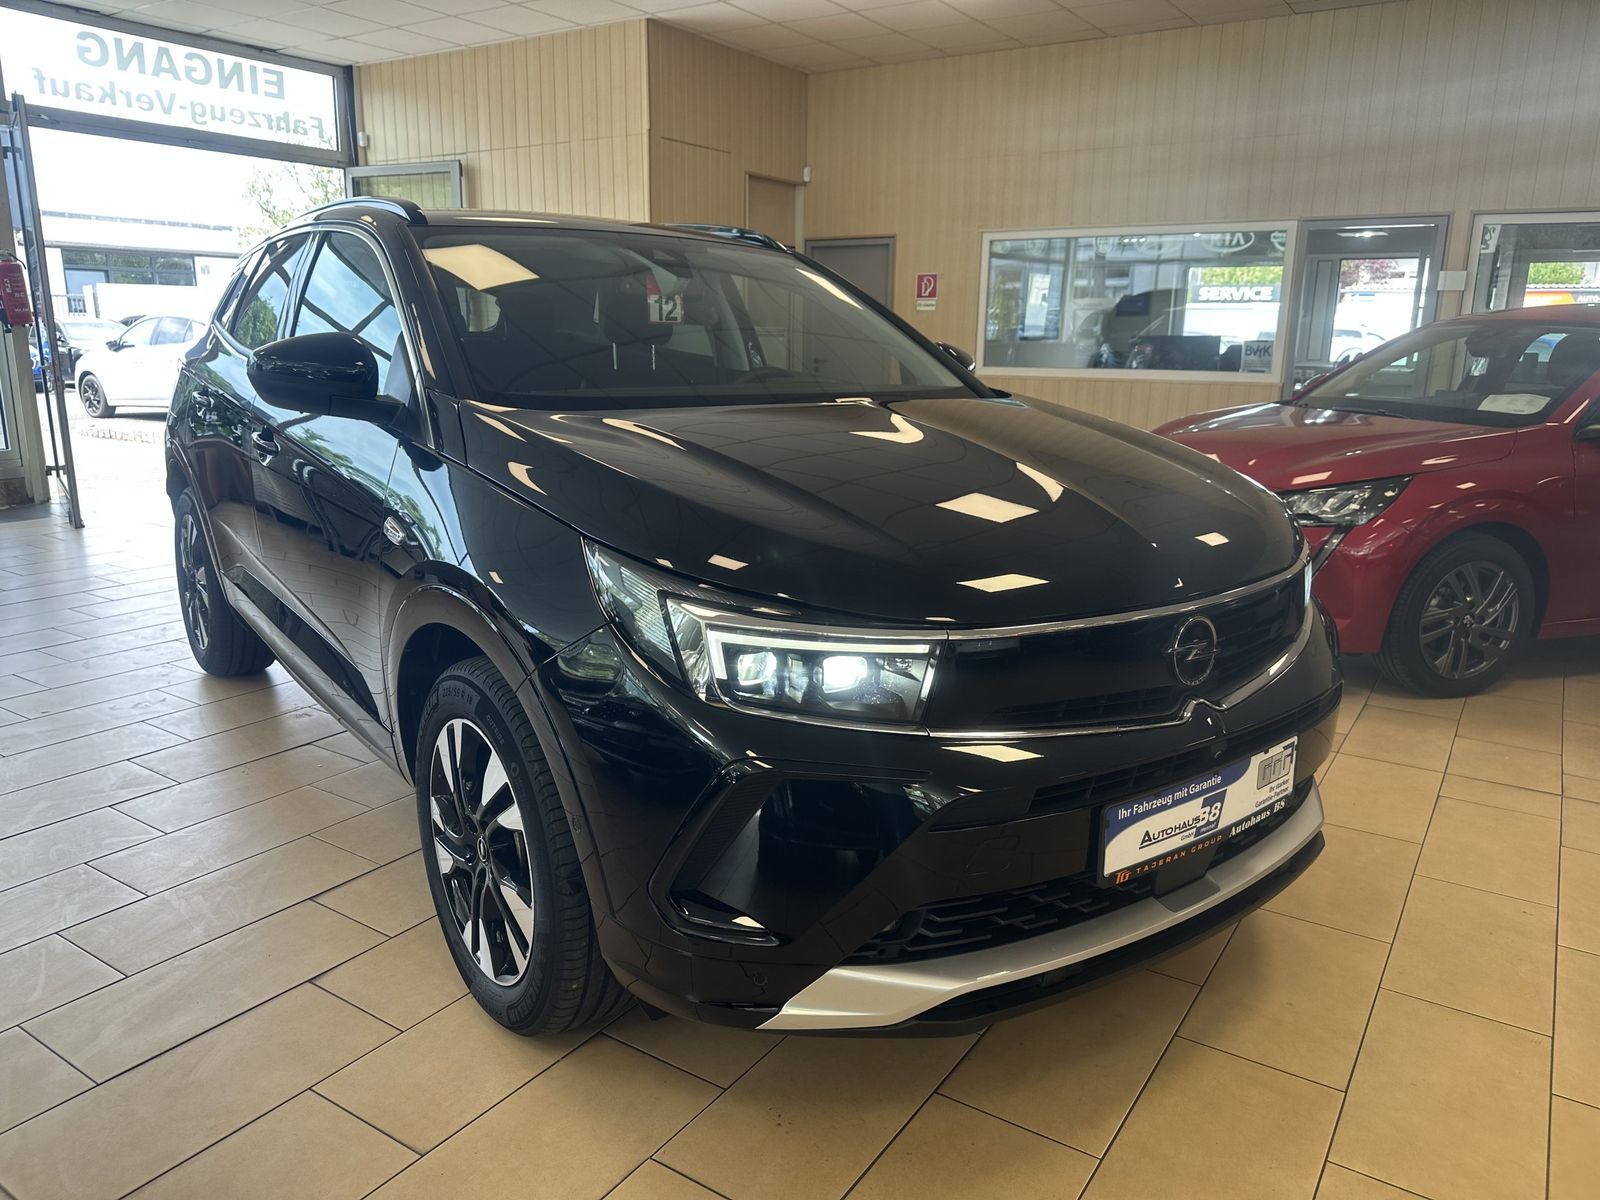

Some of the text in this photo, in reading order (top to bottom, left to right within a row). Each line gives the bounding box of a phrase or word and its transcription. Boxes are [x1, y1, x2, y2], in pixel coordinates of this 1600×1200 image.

[654, 295, 678, 321] 12
[1198, 286, 1273, 301] SERVICE
[1118, 775, 1222, 820] Ihr Fahrzeug mit Garantie
[1229, 808, 1271, 838] Autohaus
[1136, 836, 1223, 874] TAJERAN GROUP
